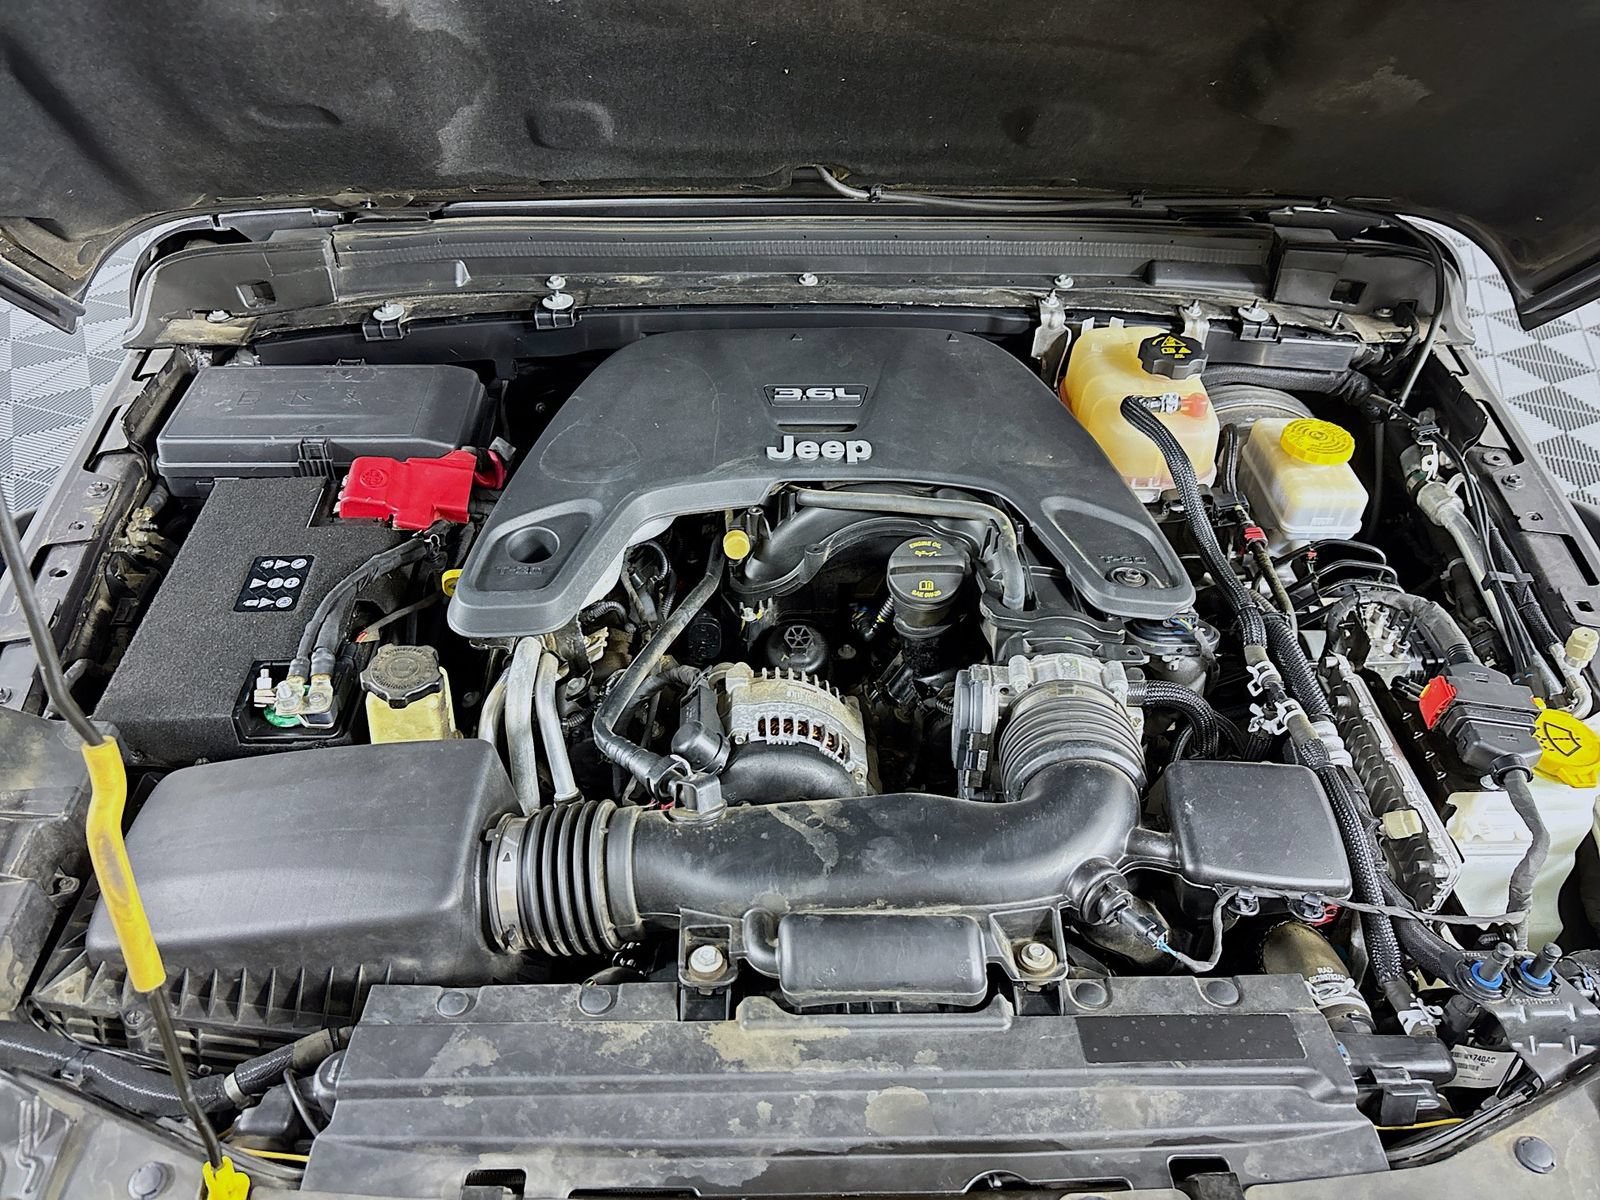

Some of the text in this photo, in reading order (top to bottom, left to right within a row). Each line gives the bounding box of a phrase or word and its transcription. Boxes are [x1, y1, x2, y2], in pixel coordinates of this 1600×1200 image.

[774, 387, 861, 401] 3.6L
[766, 435, 873, 465] Jeep
[909, 541, 942, 549] ENGINE OIL
[911, 589, 924, 598] SAE
[1316, 966, 1334, 974] RAD
